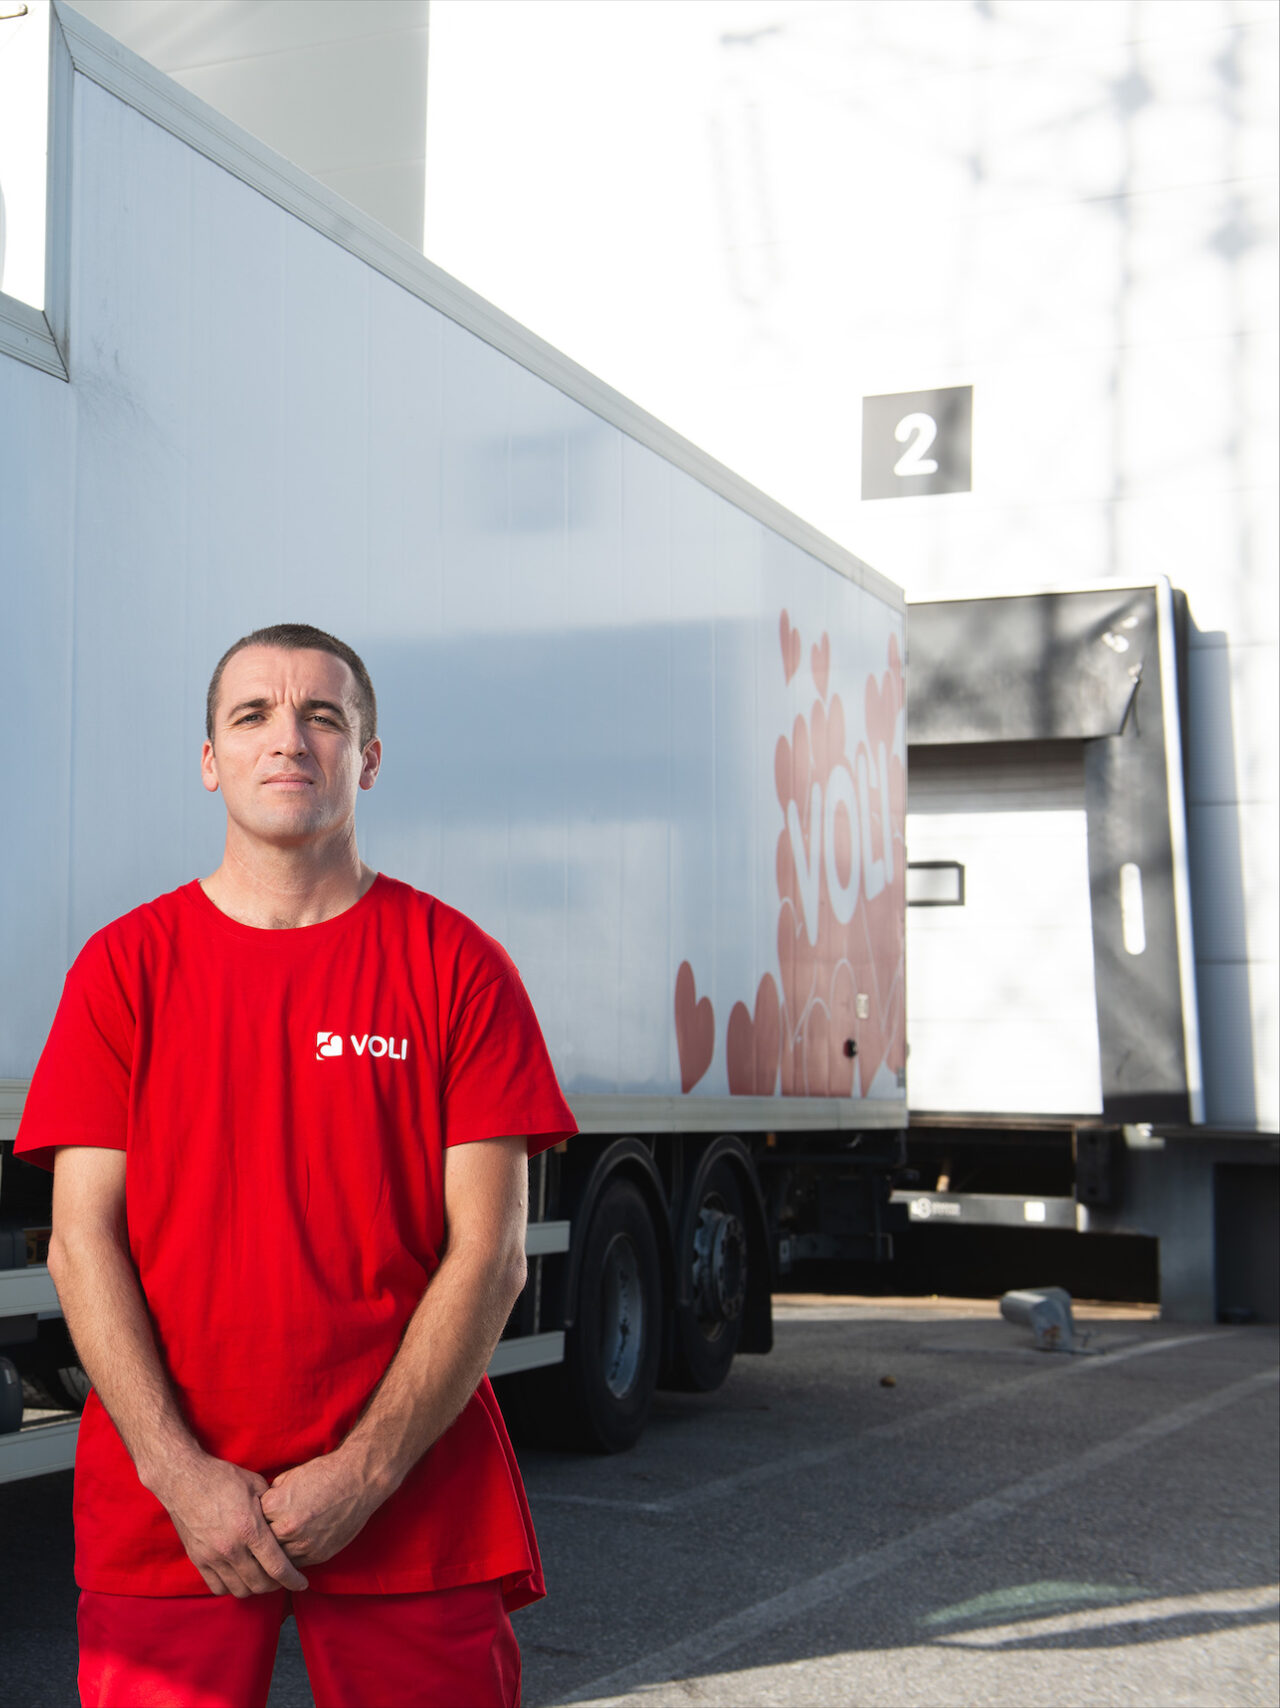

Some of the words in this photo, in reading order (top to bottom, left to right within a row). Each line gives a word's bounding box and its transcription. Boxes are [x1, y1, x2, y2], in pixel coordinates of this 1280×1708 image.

[893, 412, 939, 477] 2
[787, 740, 895, 948] VOLI
[350, 1033, 408, 1061] VOLI
